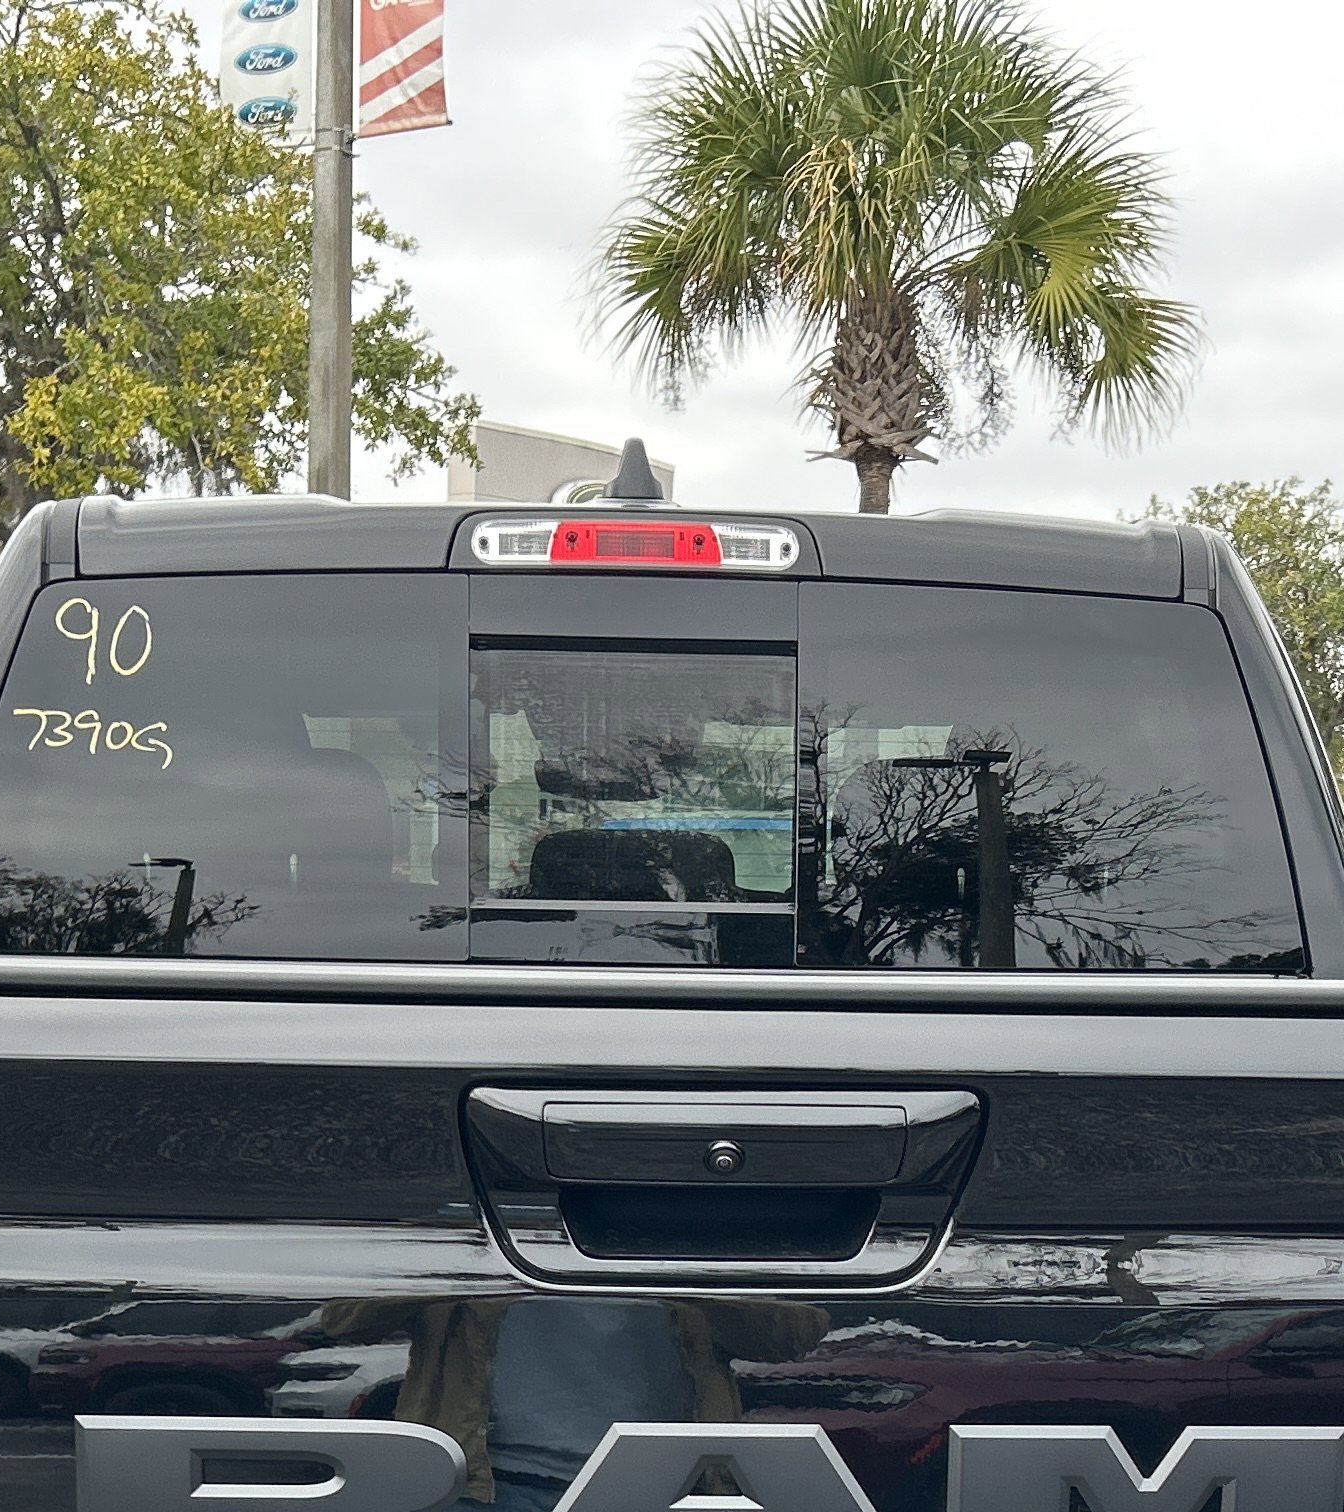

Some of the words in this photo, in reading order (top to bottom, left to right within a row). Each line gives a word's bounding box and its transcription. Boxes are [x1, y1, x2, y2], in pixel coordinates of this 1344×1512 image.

[246, 48, 286, 70] Ford
[248, 101, 287, 124] Ford
[55, 597, 152, 685] 90
